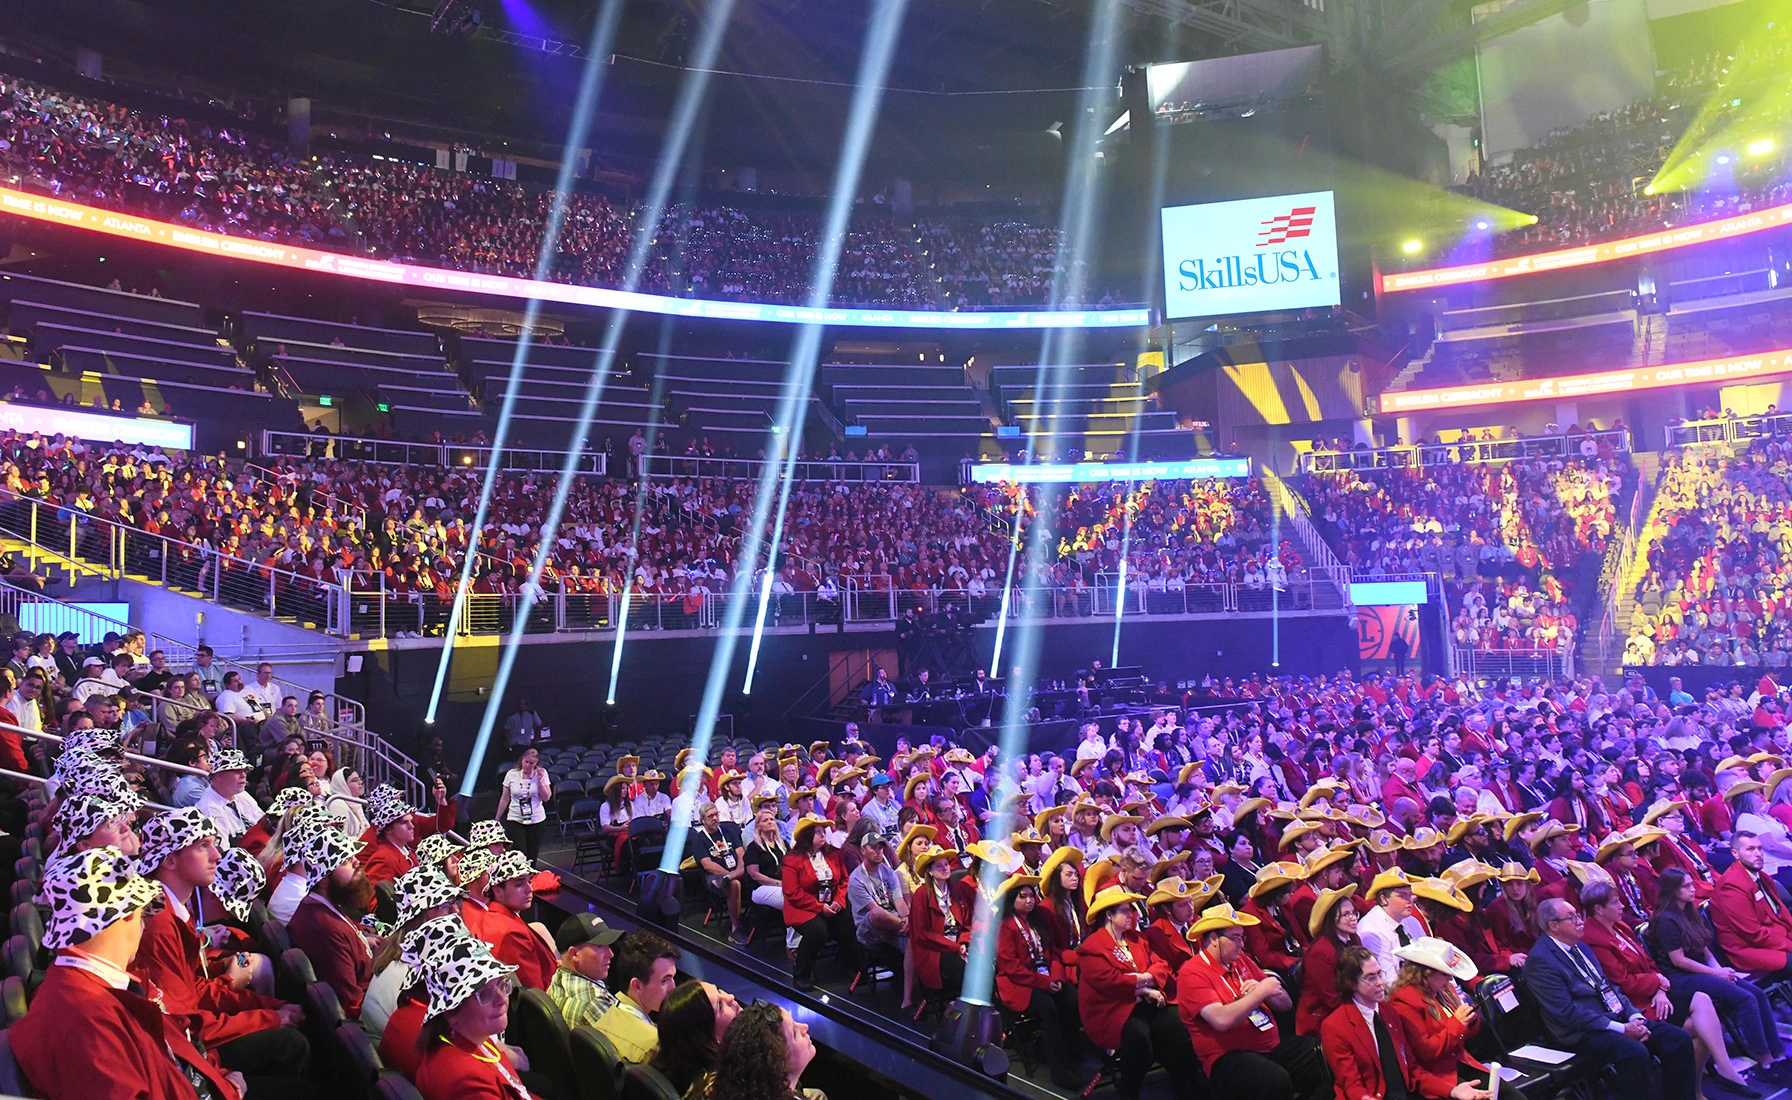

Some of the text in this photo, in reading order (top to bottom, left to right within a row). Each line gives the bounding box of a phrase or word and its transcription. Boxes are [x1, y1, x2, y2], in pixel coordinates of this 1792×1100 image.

[2, 194, 286, 260] TIME IS NOW ATLANTA EMBLEM CEREMONY
[1614, 242, 1638, 254] OUR
[1638, 238, 1662, 249] TIME
[1662, 235, 1673, 244] IS
[1673, 230, 1703, 242] NOW
[1720, 217, 1763, 233] ATLANTA
[1179, 250, 1322, 291] SkillsUSA
[1396, 268, 1487, 287] EMBLEM CEREMONY
[423, 272, 446, 283] OUR
[447, 275, 470, 286] TIME
[471, 278, 481, 288] IS
[482, 280, 509, 290] NOW
[776, 310, 990, 325] OUR TIME IS NOW ATLANTA EMBLEM CEREMONY
[1656, 369, 1684, 381] OUR
[1684, 366, 1713, 378] TIME
[1714, 364, 1727, 374] IS
[1727, 359, 1763, 372] NOW
[1395, 388, 1503, 407] EMBLEM CEREMONY
[52, 416, 110, 435] EMBLEM
[112, 423, 187, 443] CEREMONY
[1089, 469, 1109, 477] OUR
[1109, 468, 1131, 477] TIME
[1132, 468, 1141, 476] IS
[1141, 466, 1168, 475] NOW
[1182, 465, 1221, 474] ATLANTA
